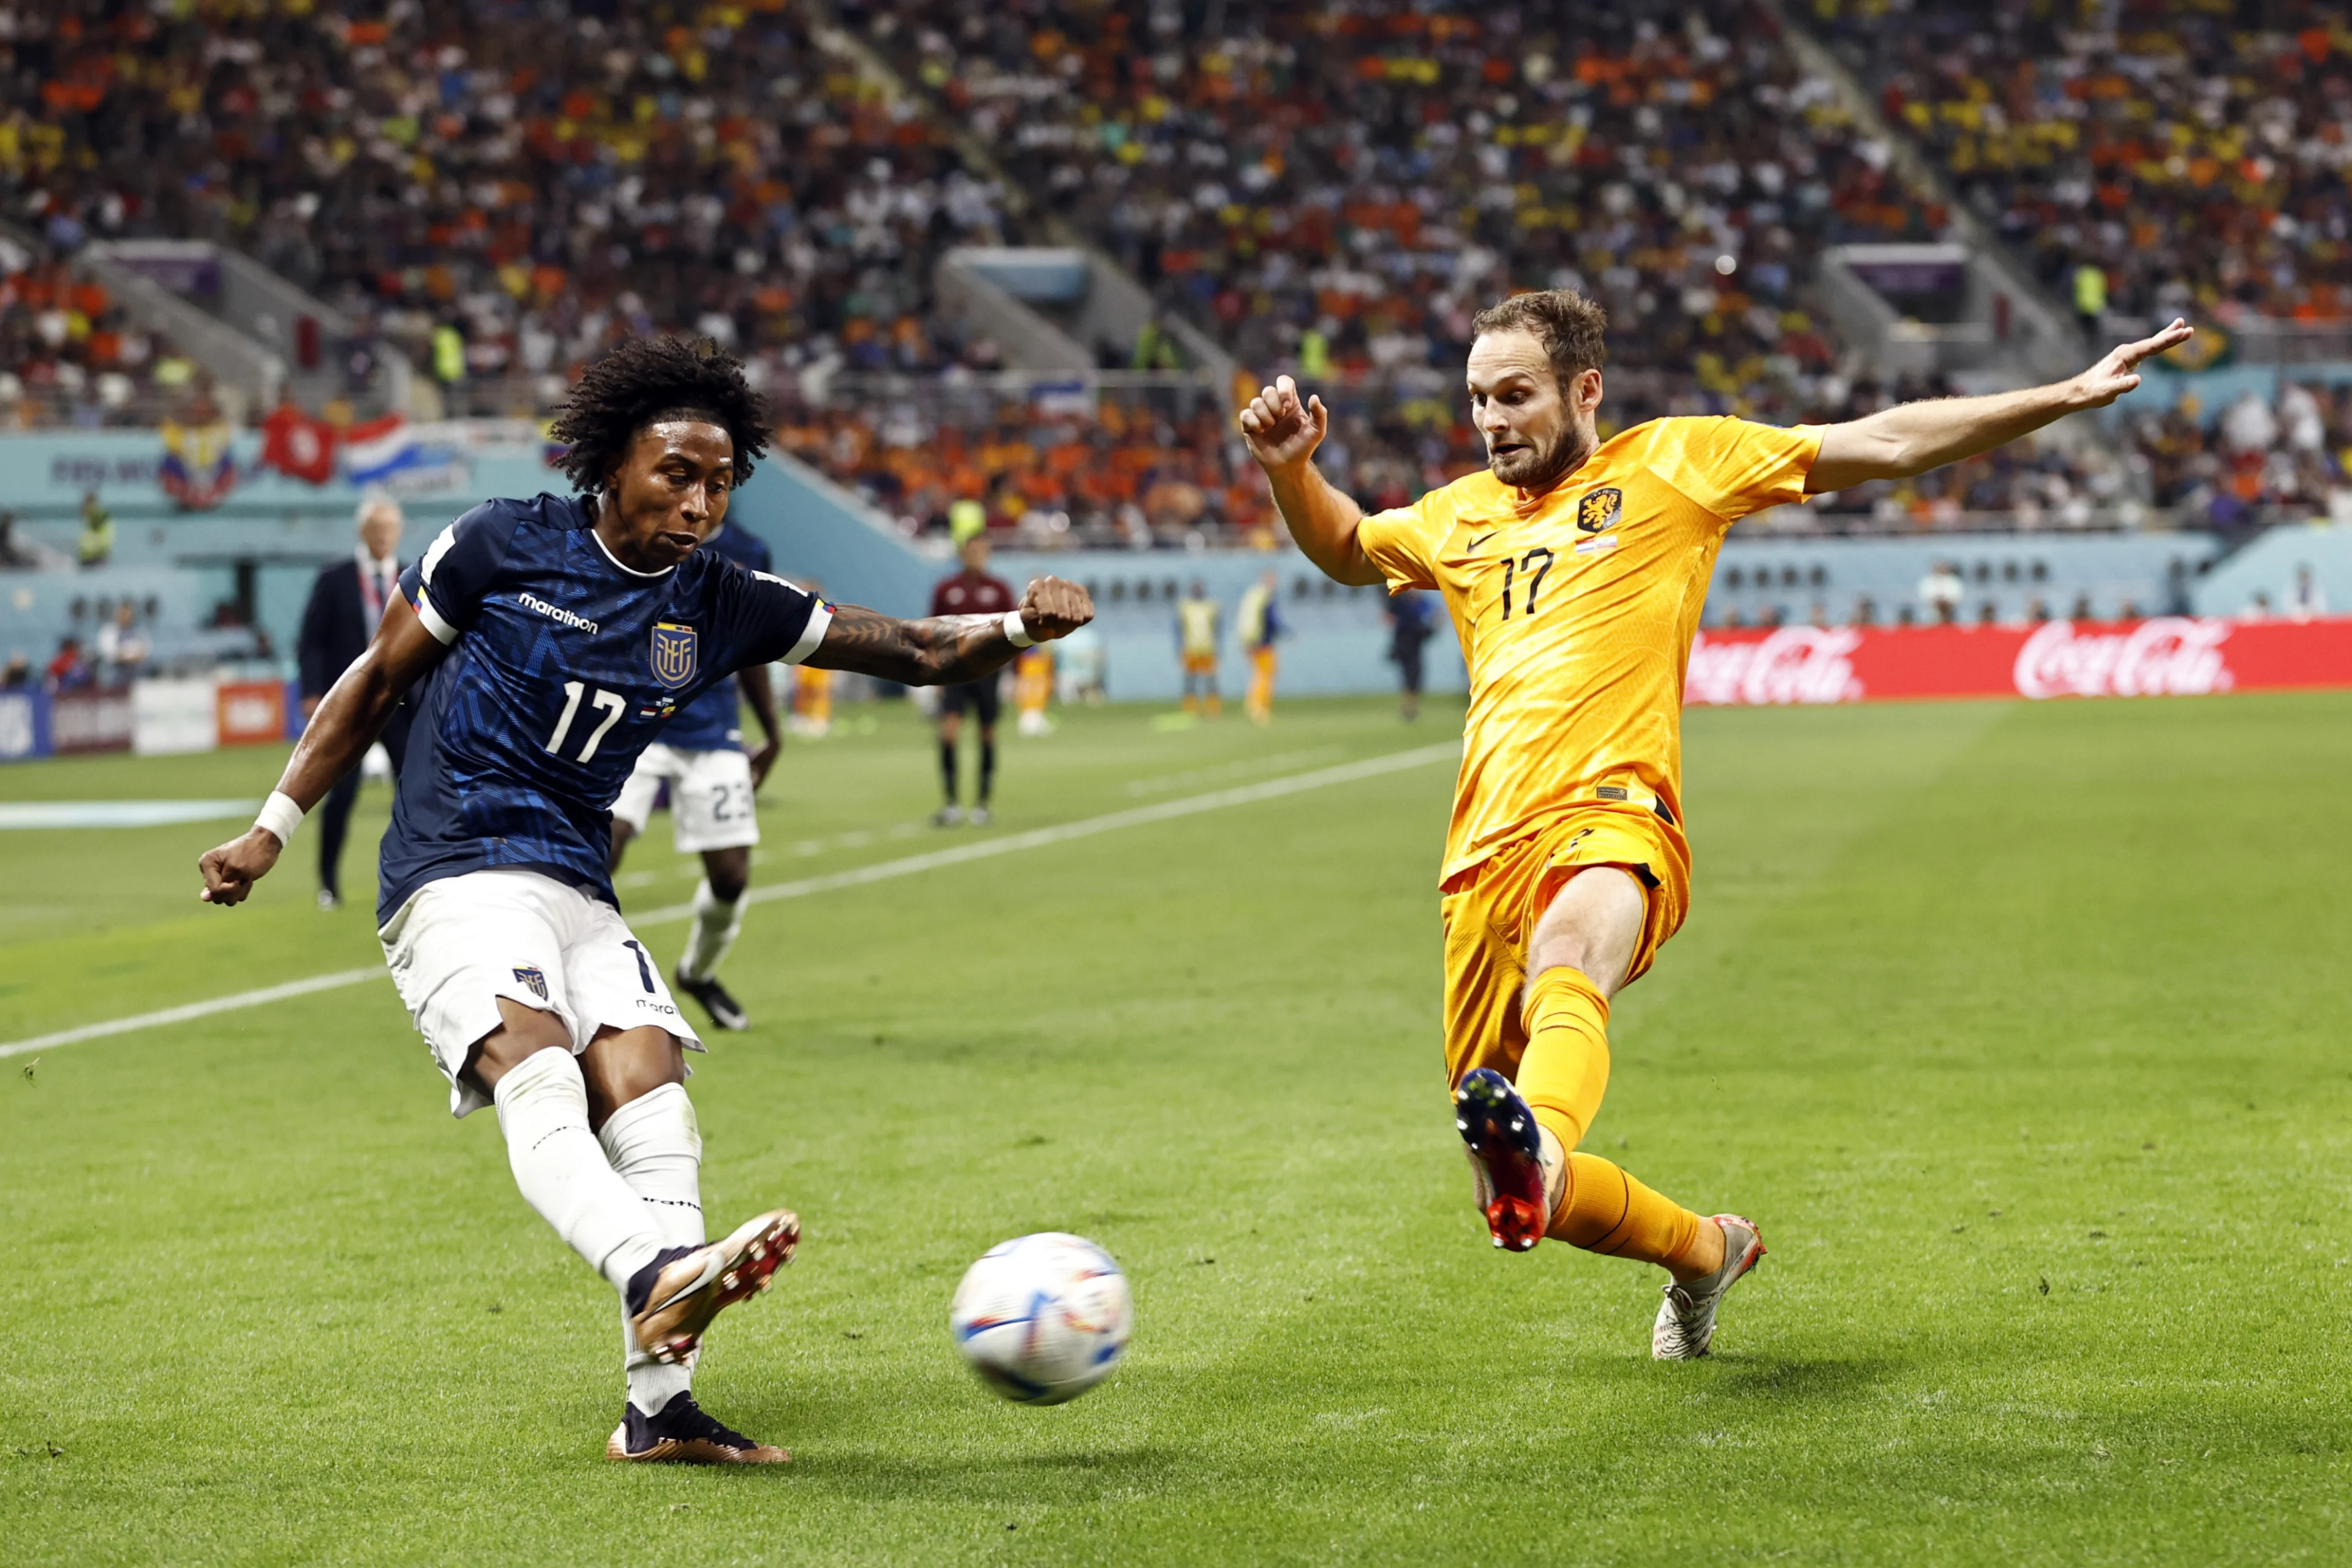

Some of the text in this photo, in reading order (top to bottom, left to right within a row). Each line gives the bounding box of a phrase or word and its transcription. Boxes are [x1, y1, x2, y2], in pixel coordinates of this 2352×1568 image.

[518, 592, 598, 635] marathon
[1500, 547, 1554, 621] 17
[1684, 625, 1864, 704] ca-Cola
[2013, 616, 2237, 699] Coca-Cola
[545, 680, 627, 764] 17
